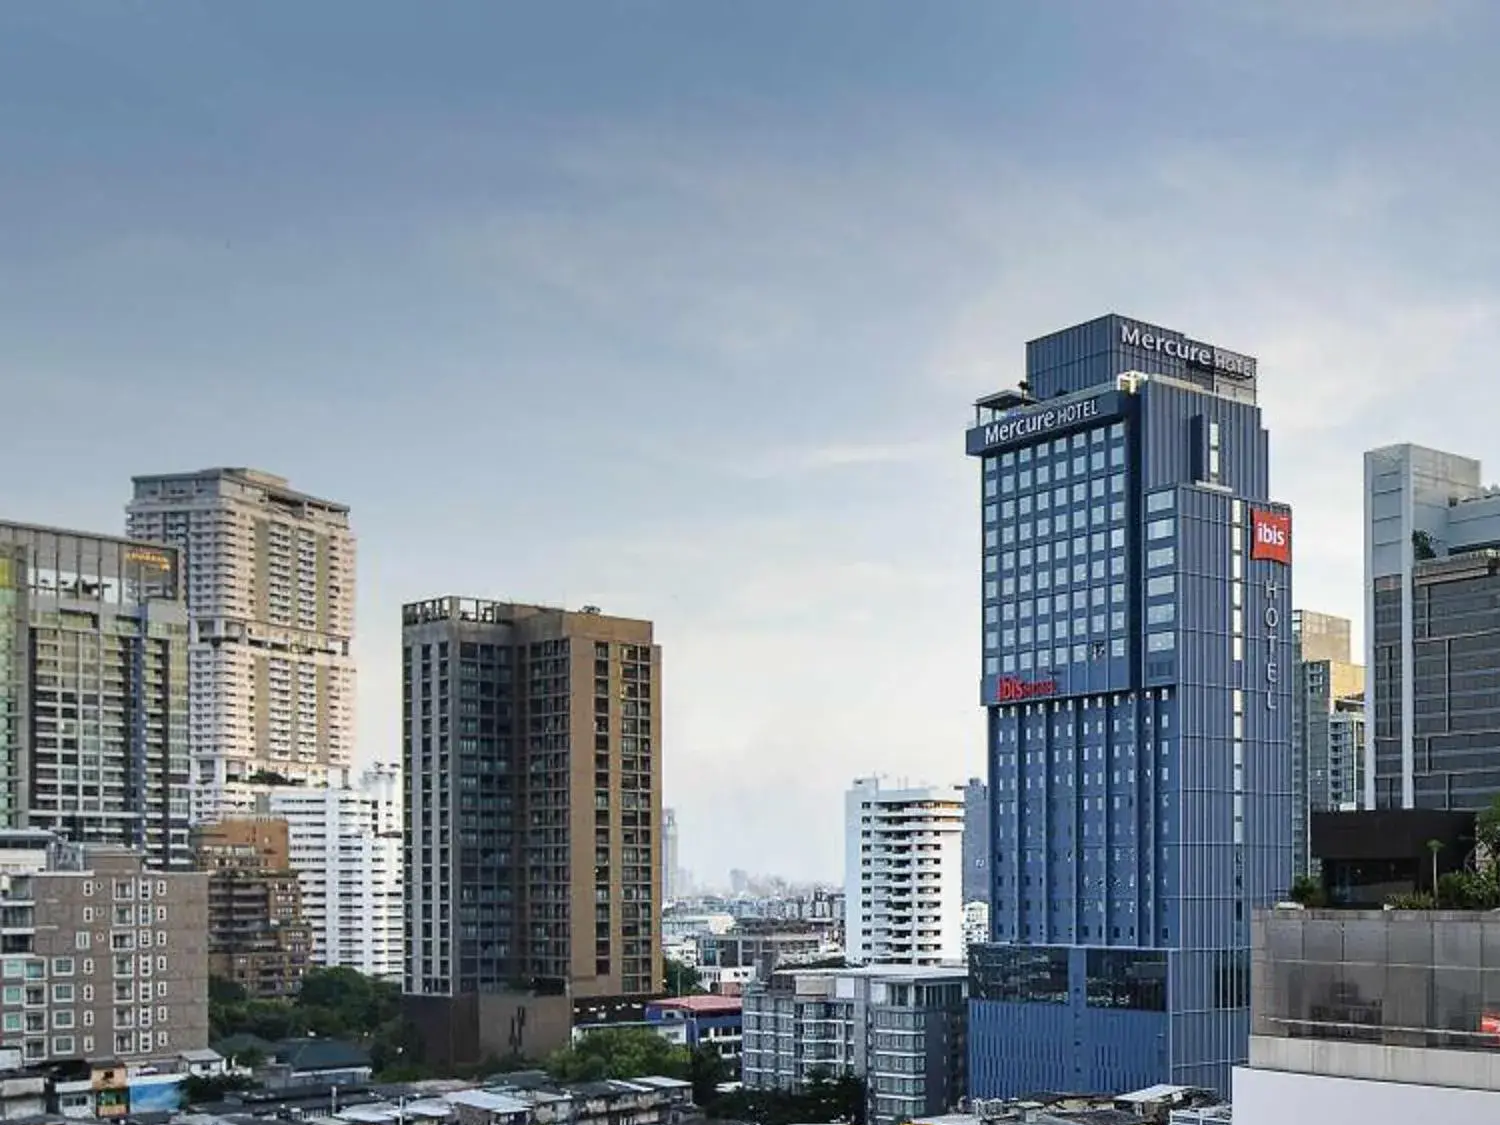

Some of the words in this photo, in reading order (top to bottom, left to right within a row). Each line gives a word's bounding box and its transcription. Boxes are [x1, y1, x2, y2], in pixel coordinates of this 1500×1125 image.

[1120, 324, 1211, 365] Mercure
[985, 411, 1055, 445] Mercure
[1057, 399, 1098, 425] HOTEL
[1257, 522, 1285, 546] ibis
[1265, 579, 1279, 710] HOTEL
